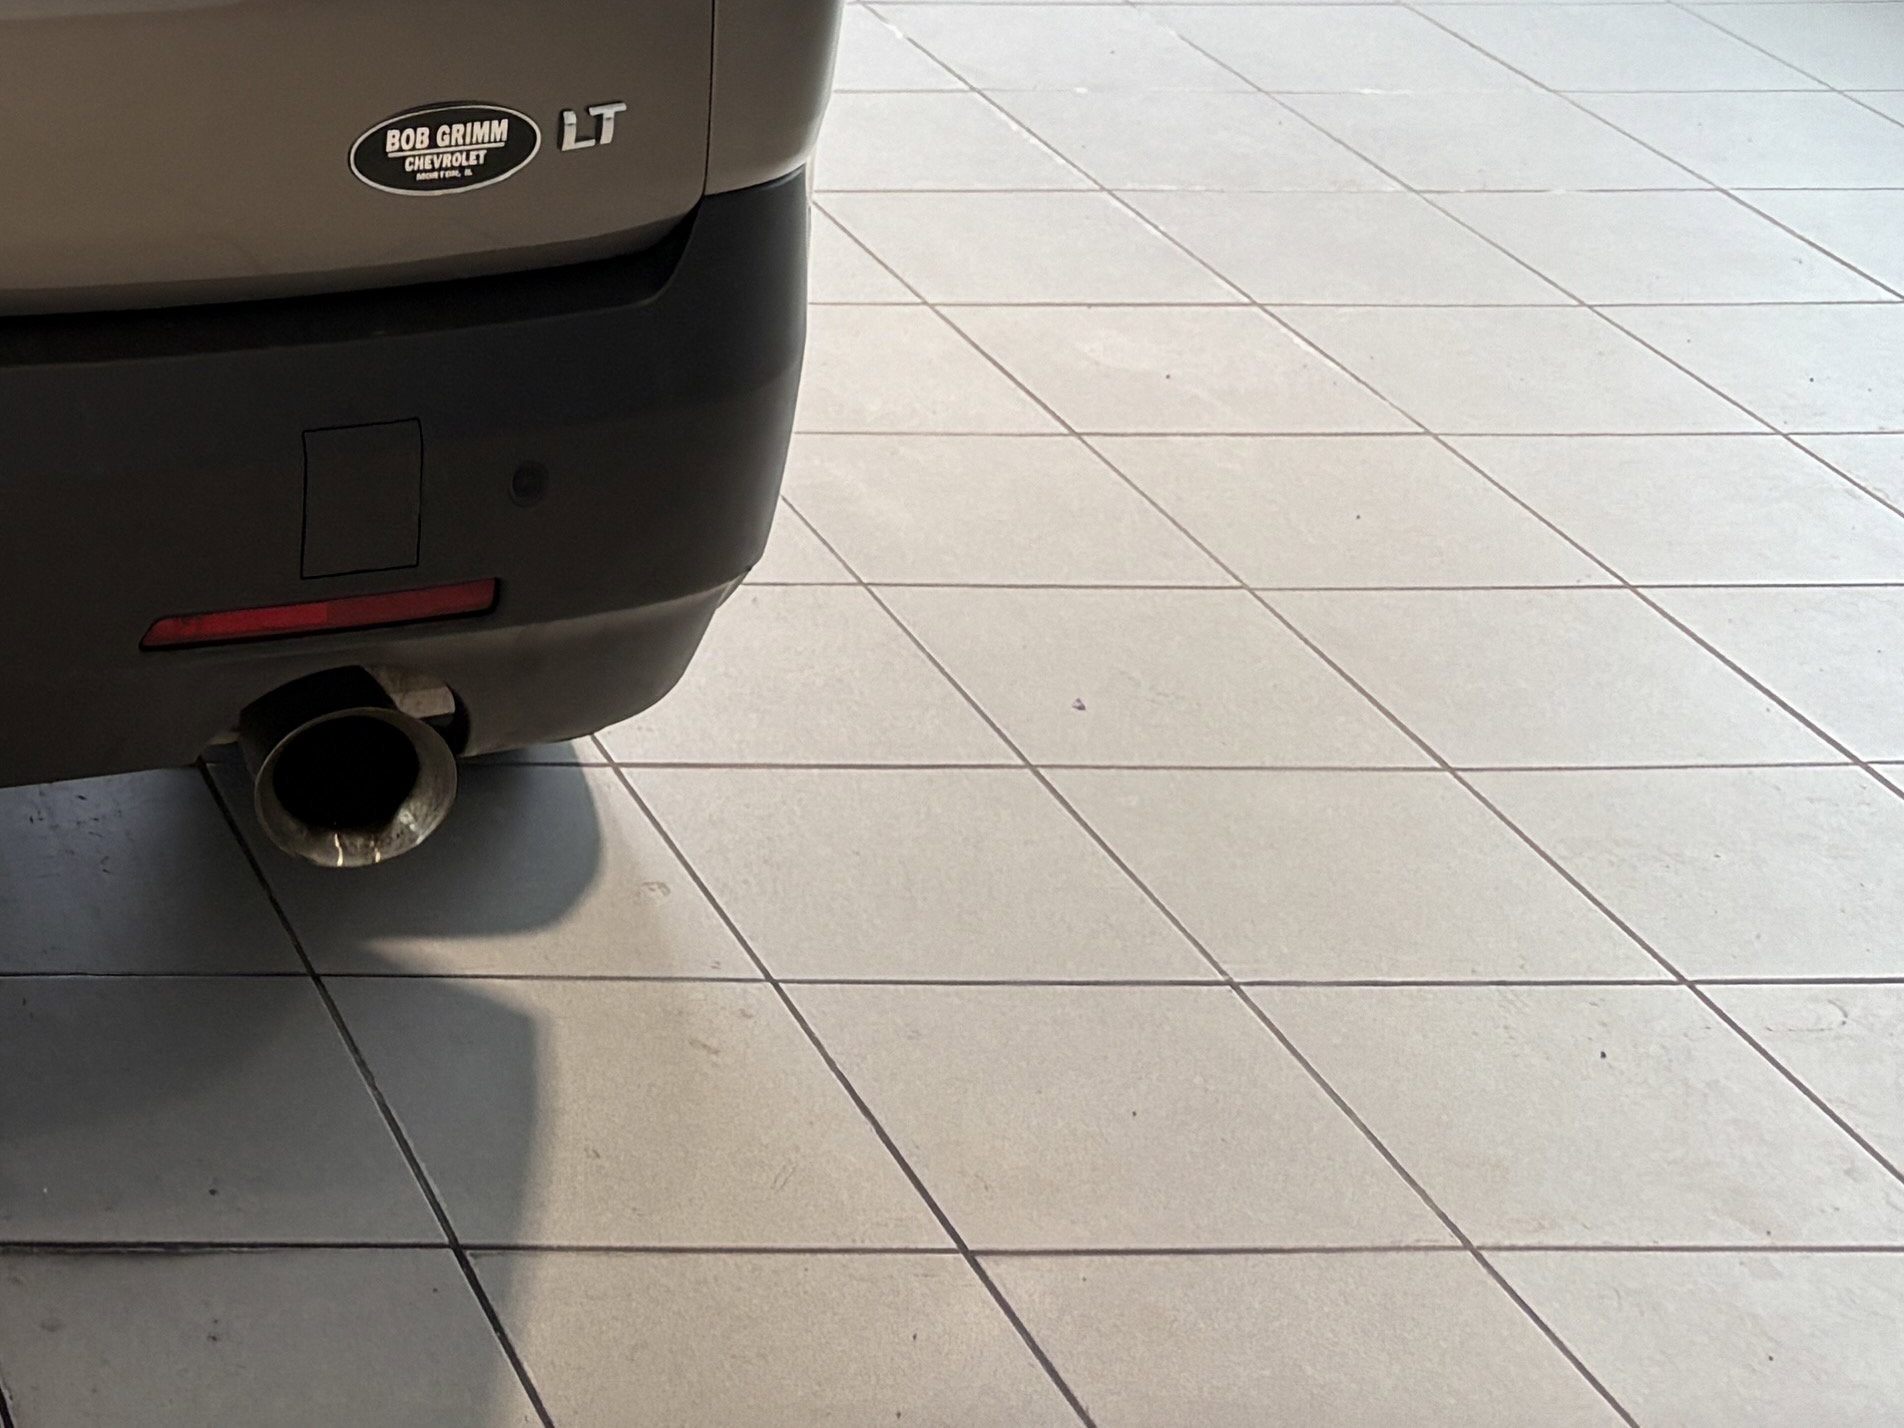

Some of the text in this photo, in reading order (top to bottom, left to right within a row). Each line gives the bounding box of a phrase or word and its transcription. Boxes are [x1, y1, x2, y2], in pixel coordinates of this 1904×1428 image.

[386, 118, 509, 153] BOB GRIMM
[561, 102, 627, 152] LT
[404, 149, 488, 173] CHEVROLET
